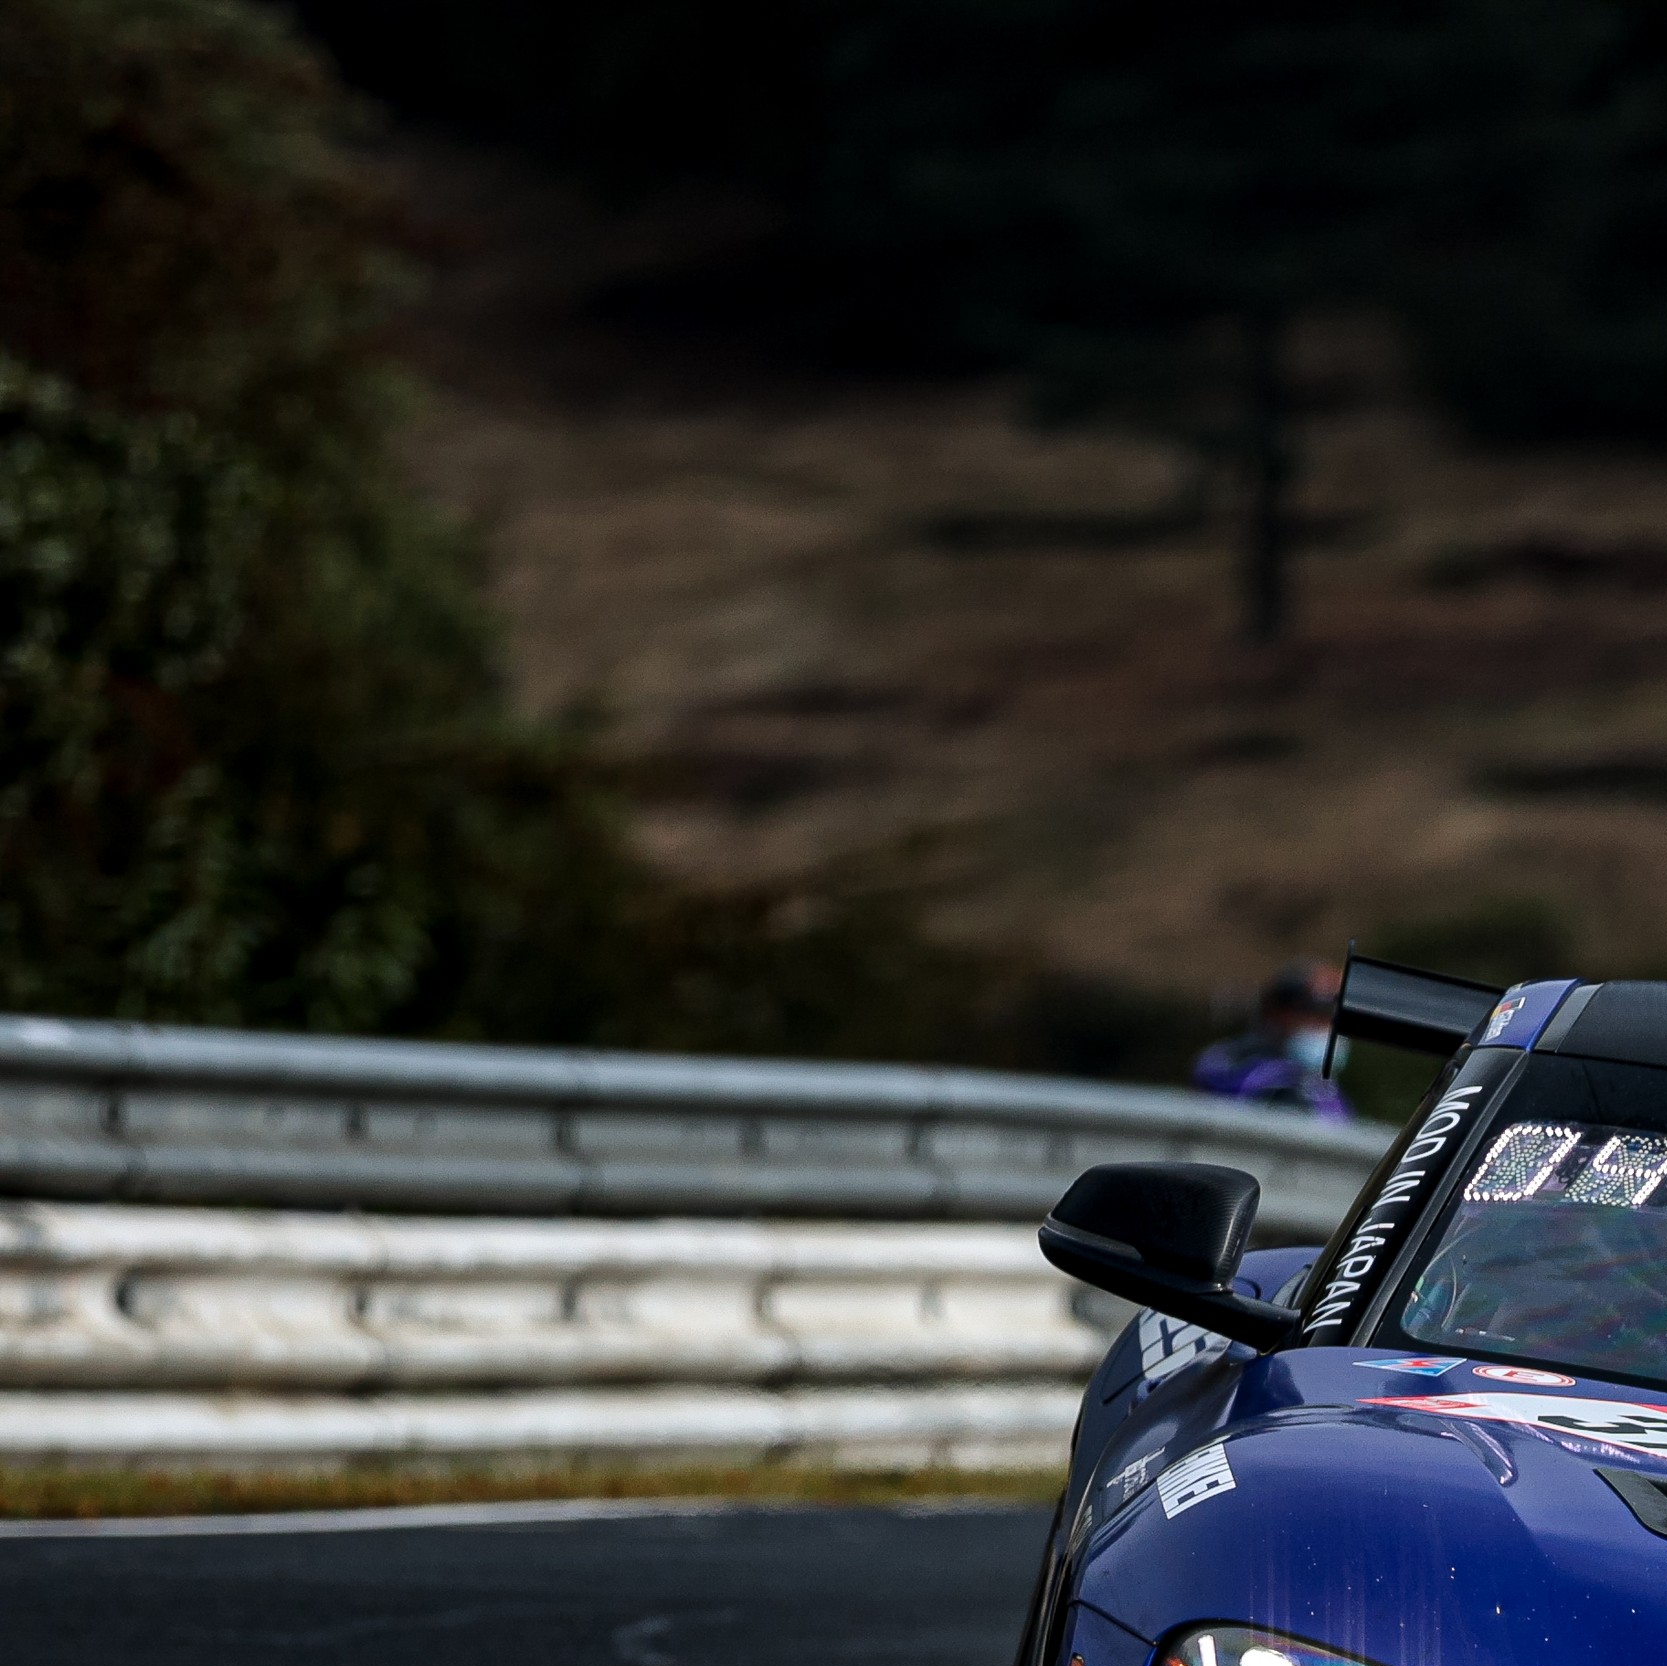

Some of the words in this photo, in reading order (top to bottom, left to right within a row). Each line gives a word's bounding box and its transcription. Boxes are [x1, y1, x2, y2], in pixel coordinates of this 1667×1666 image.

[1401, 1086, 1482, 1163] MOD
[1371, 1171, 1425, 1210] IN
[1303, 1217, 1395, 1334] JAPAN
